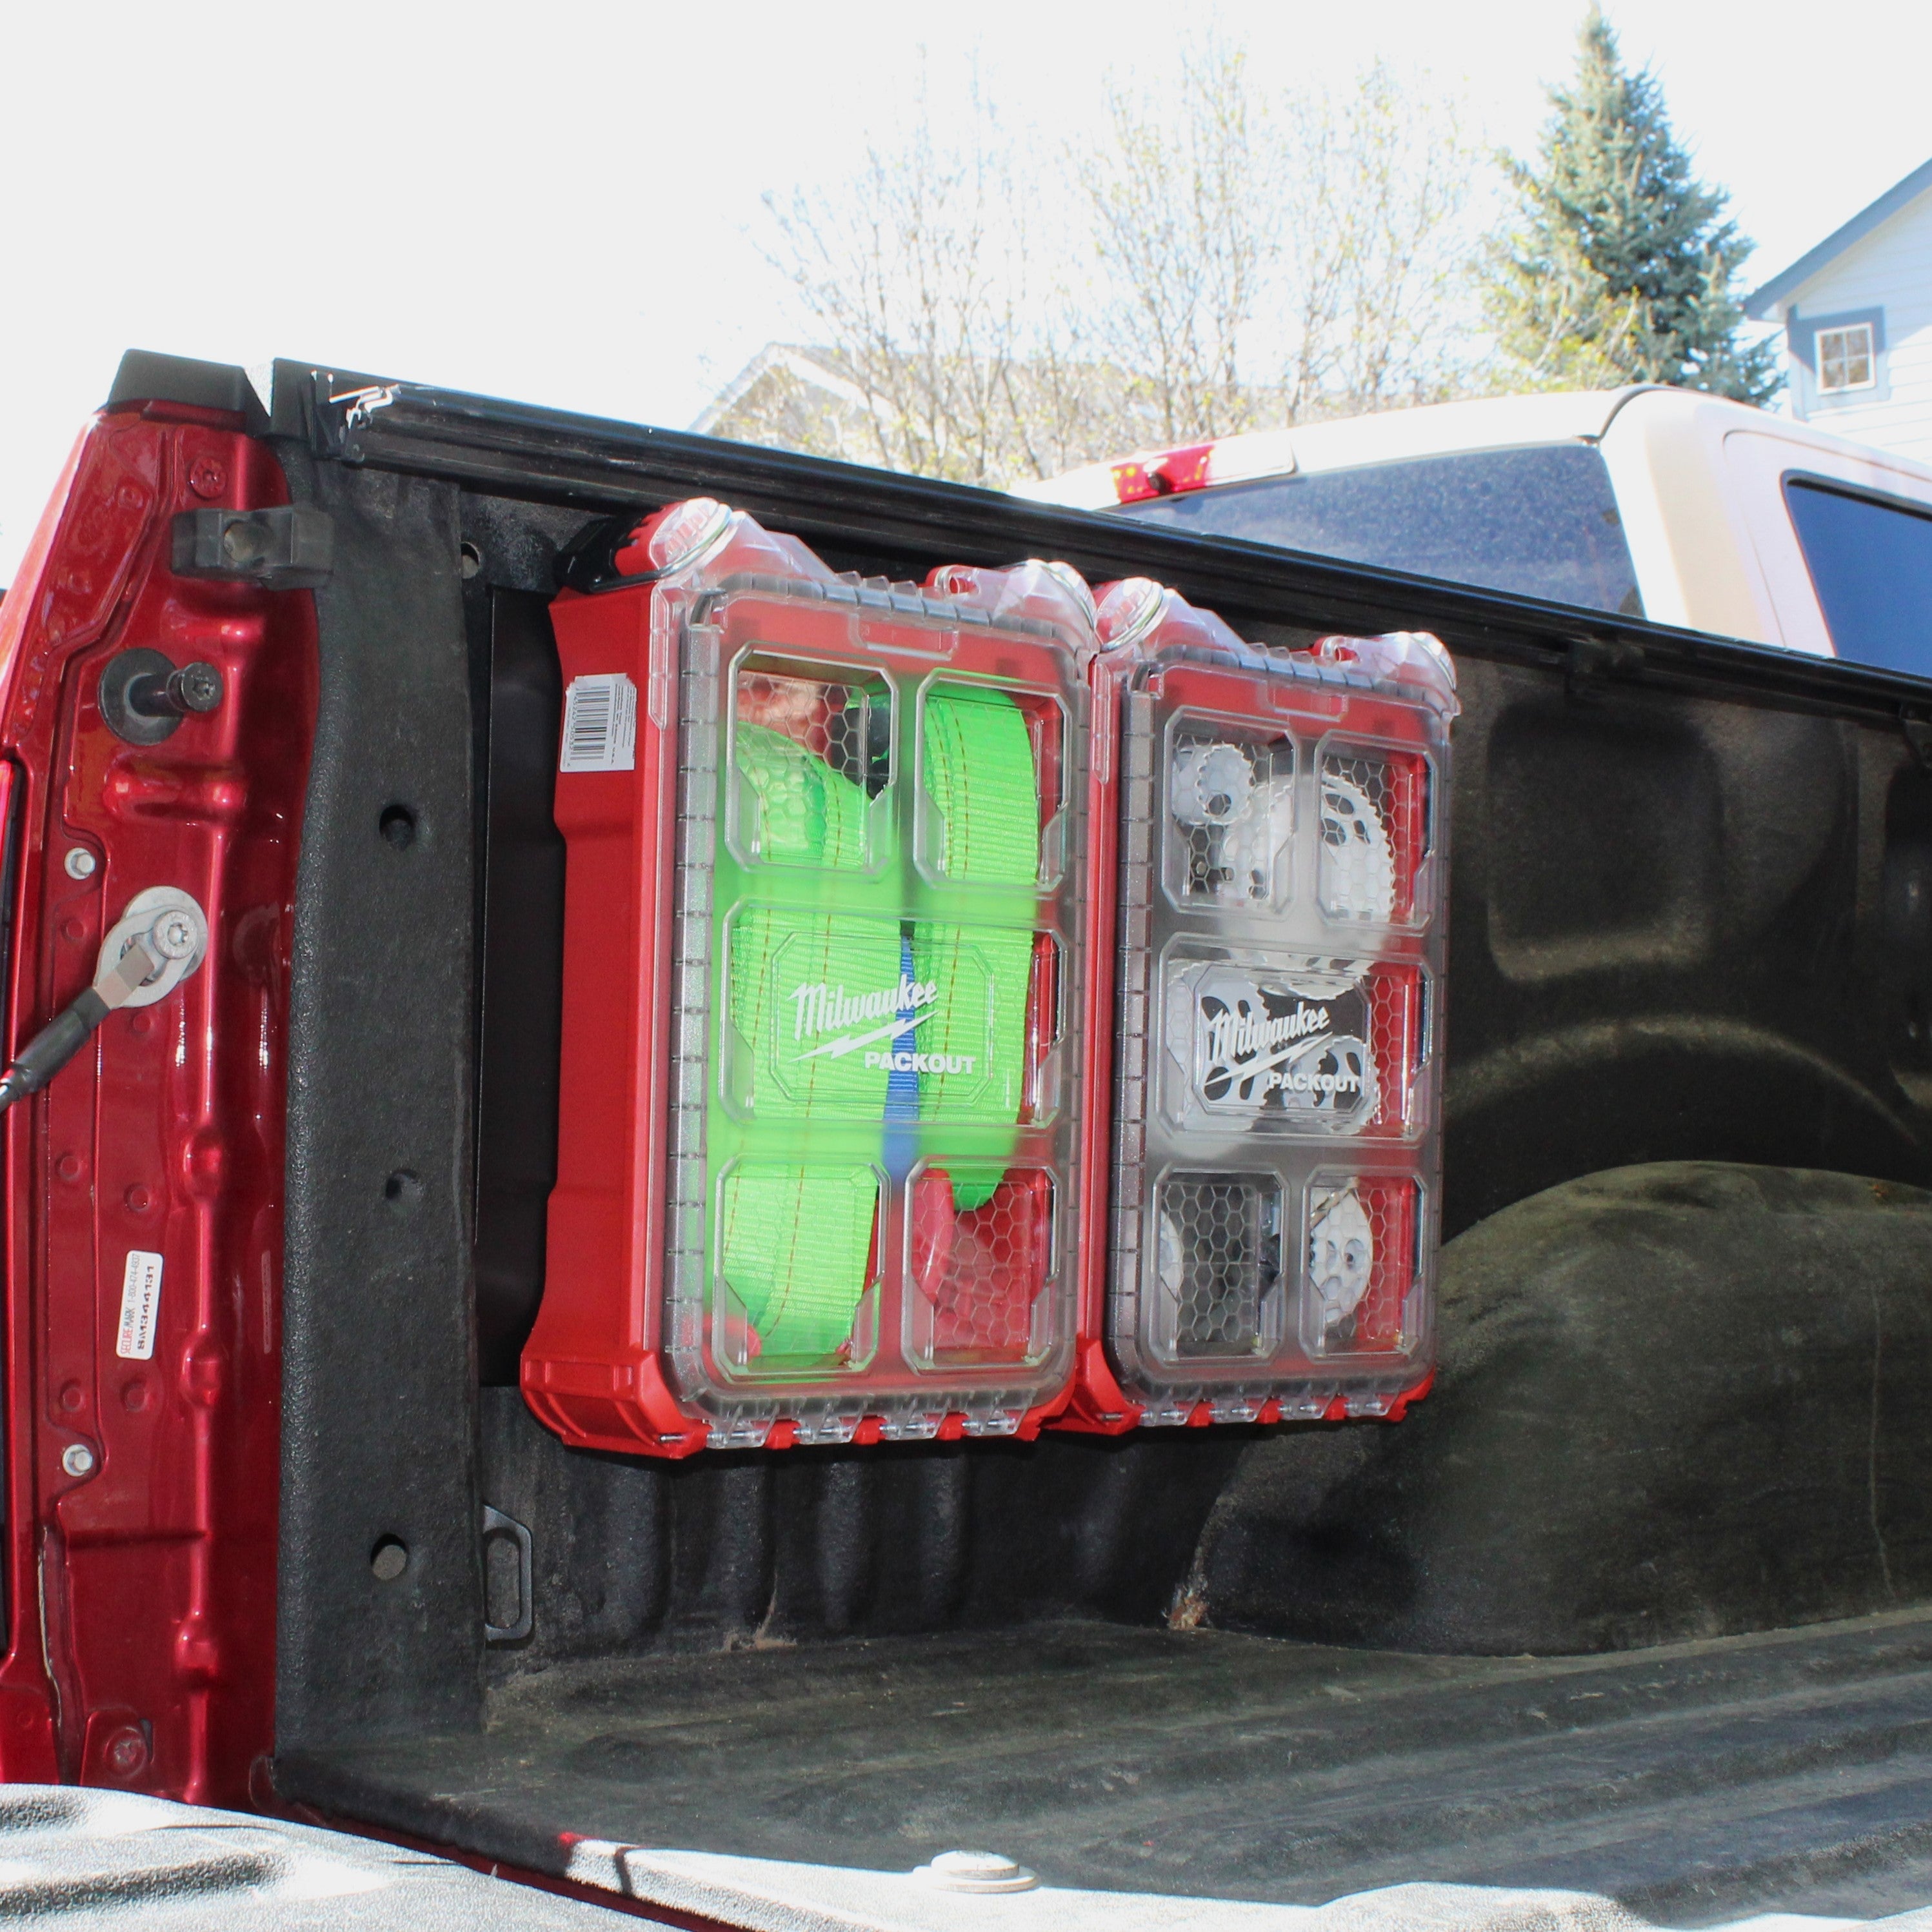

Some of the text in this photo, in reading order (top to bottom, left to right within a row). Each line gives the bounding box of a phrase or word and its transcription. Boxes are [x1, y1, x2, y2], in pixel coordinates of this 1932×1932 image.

[787, 973, 939, 1042] Milwaukee
[1207, 1001, 1331, 1066] Milwaukee
[864, 1051, 976, 1074] PACKOUT
[1268, 1072, 1360, 1092] PACKOUT
